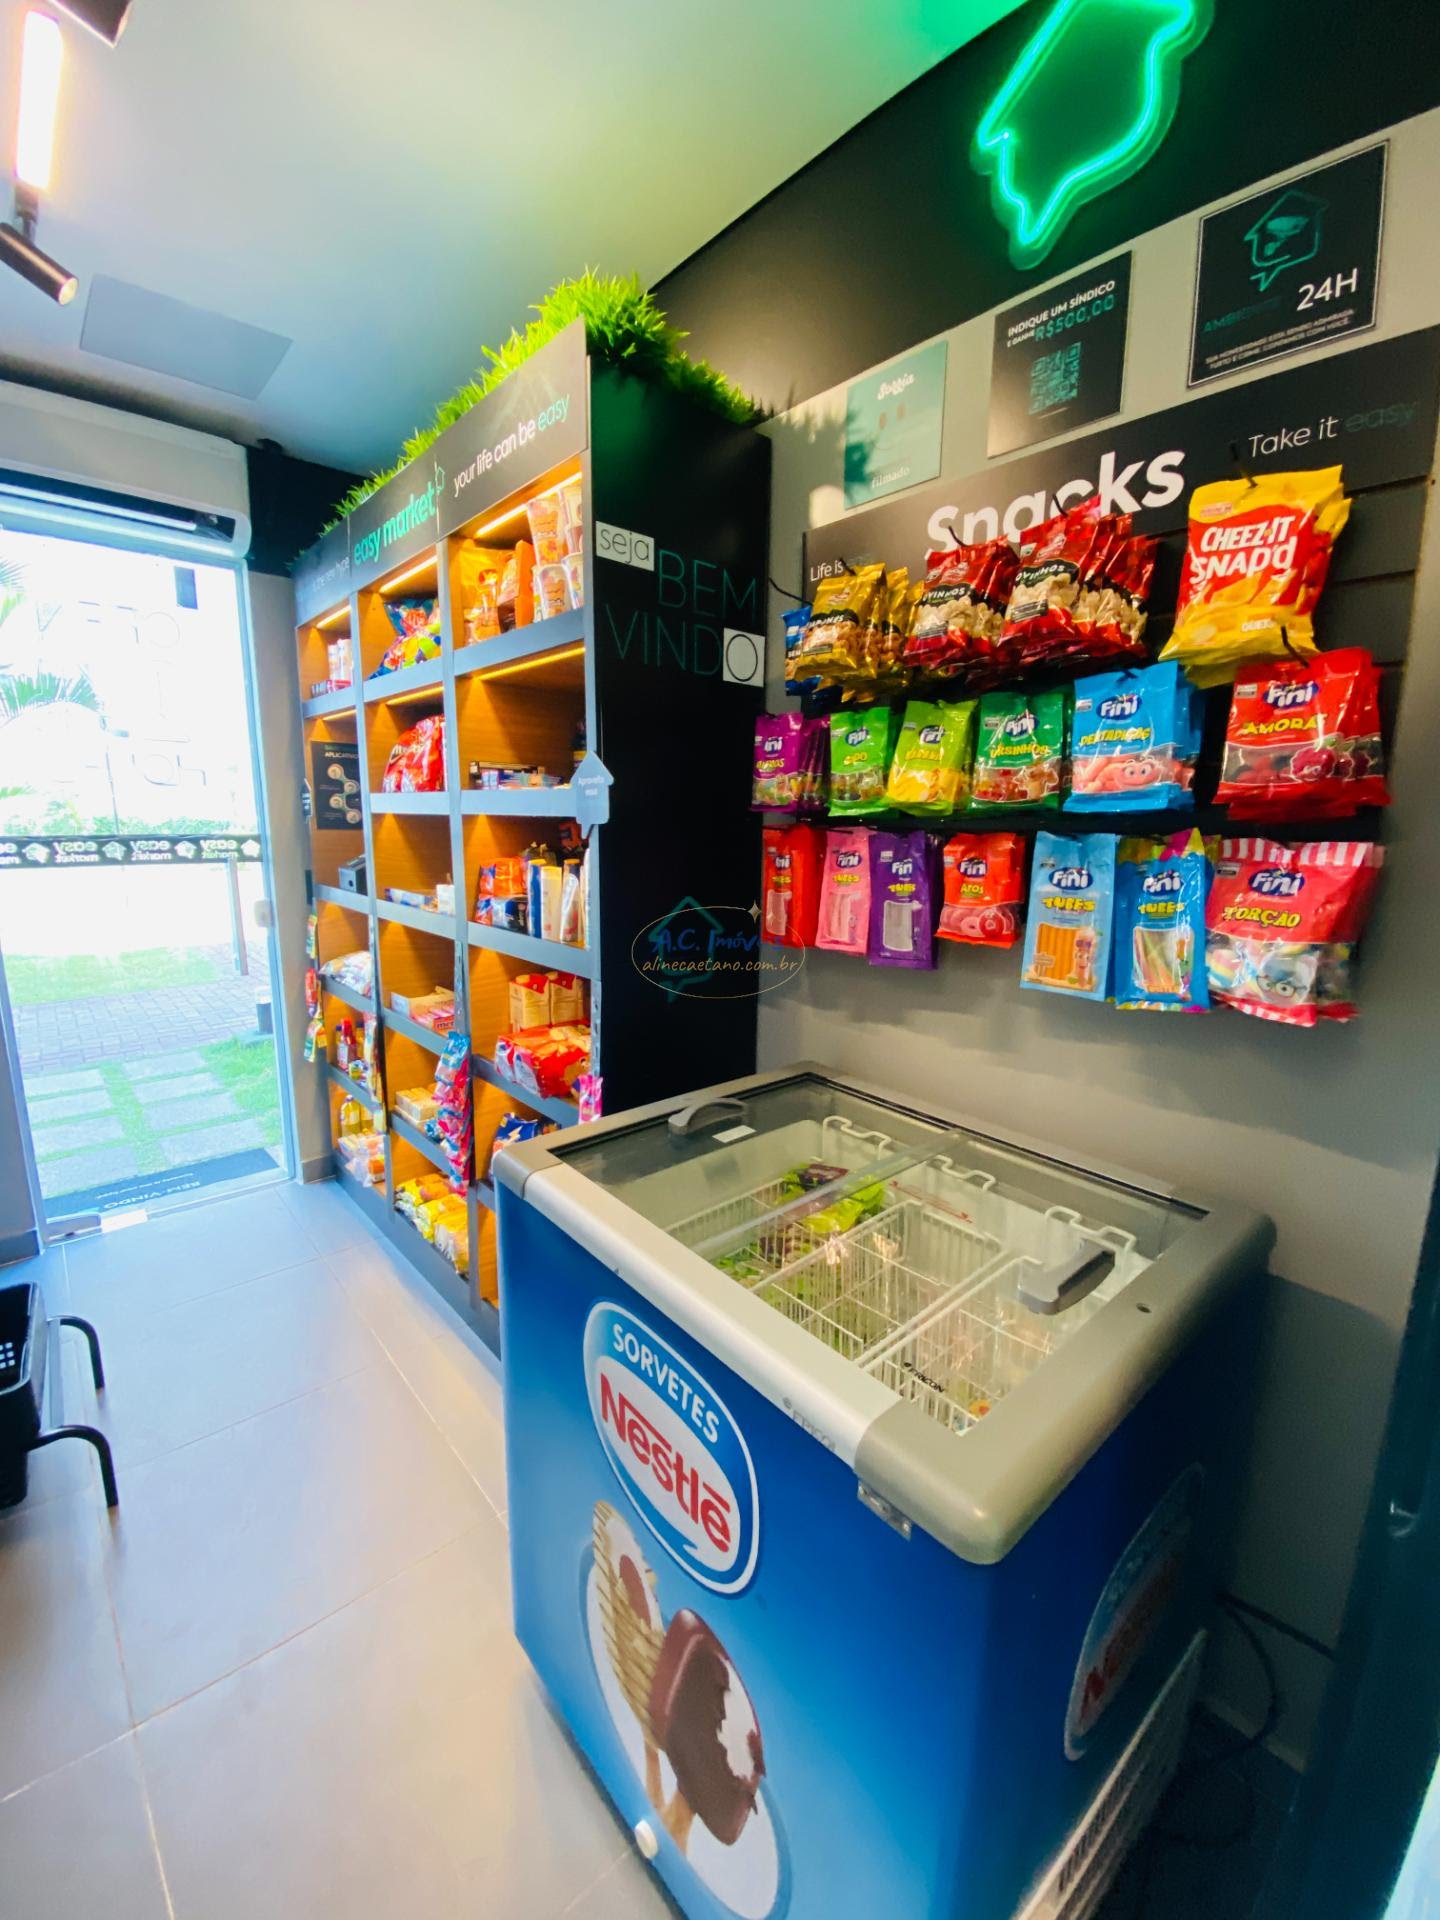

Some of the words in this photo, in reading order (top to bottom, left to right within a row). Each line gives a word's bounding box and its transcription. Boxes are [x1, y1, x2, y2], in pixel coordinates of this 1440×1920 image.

[1297, 268, 1358, 312] 24H
[1008, 310, 1049, 336] INDIQUE
[1050, 304, 1068, 317] UM
[1069, 280, 1116, 309] SÍNDICO
[453, 465, 475, 498] your
[476, 447, 493, 476] life
[494, 433, 517, 464] can
[516, 418, 536, 446] be
[537, 393, 571, 431] easy
[1249, 427, 1312, 458] Take
[1319, 416, 1340, 441] it
[872, 465, 910, 488] filmado
[353, 525, 382, 566] easy
[382, 480, 436, 548] market
[599, 529, 650, 564] seja
[658, 549, 757, 625] BEM
[810, 562, 834, 583] Life
[605, 603, 759, 683] VINDO
[1101, 694, 1139, 718] Fini
[1267, 680, 1315, 708] Fini
[1052, 869, 1089, 889] Fini
[1143, 872, 1182, 894] Fini
[1251, 872, 1303, 896] Fini
[1042, 896, 1096, 912] TUBES
[612, 1323, 720, 1444] SORVETES
